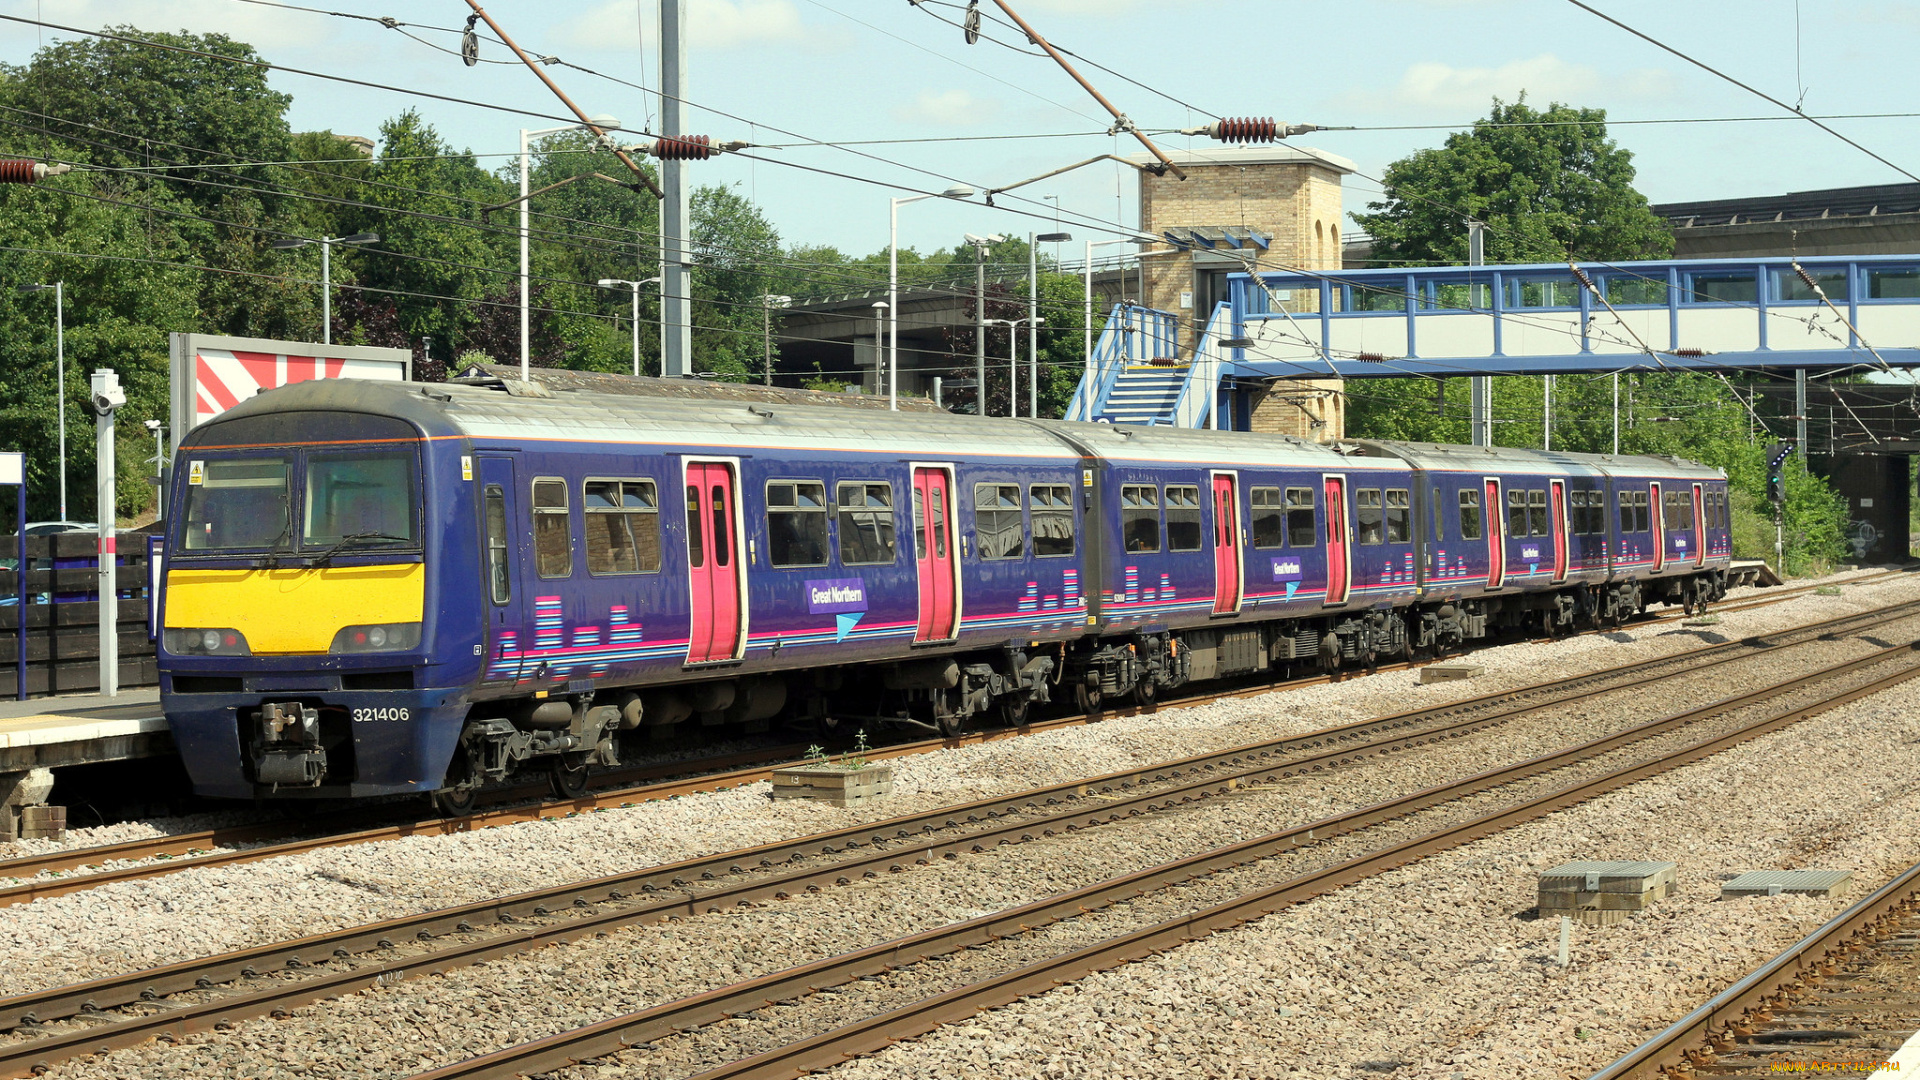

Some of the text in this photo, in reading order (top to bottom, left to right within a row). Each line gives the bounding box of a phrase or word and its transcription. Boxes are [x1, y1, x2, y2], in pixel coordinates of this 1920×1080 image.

[812, 586, 862, 604] Great Northern
[353, 707, 410, 722] 321406
